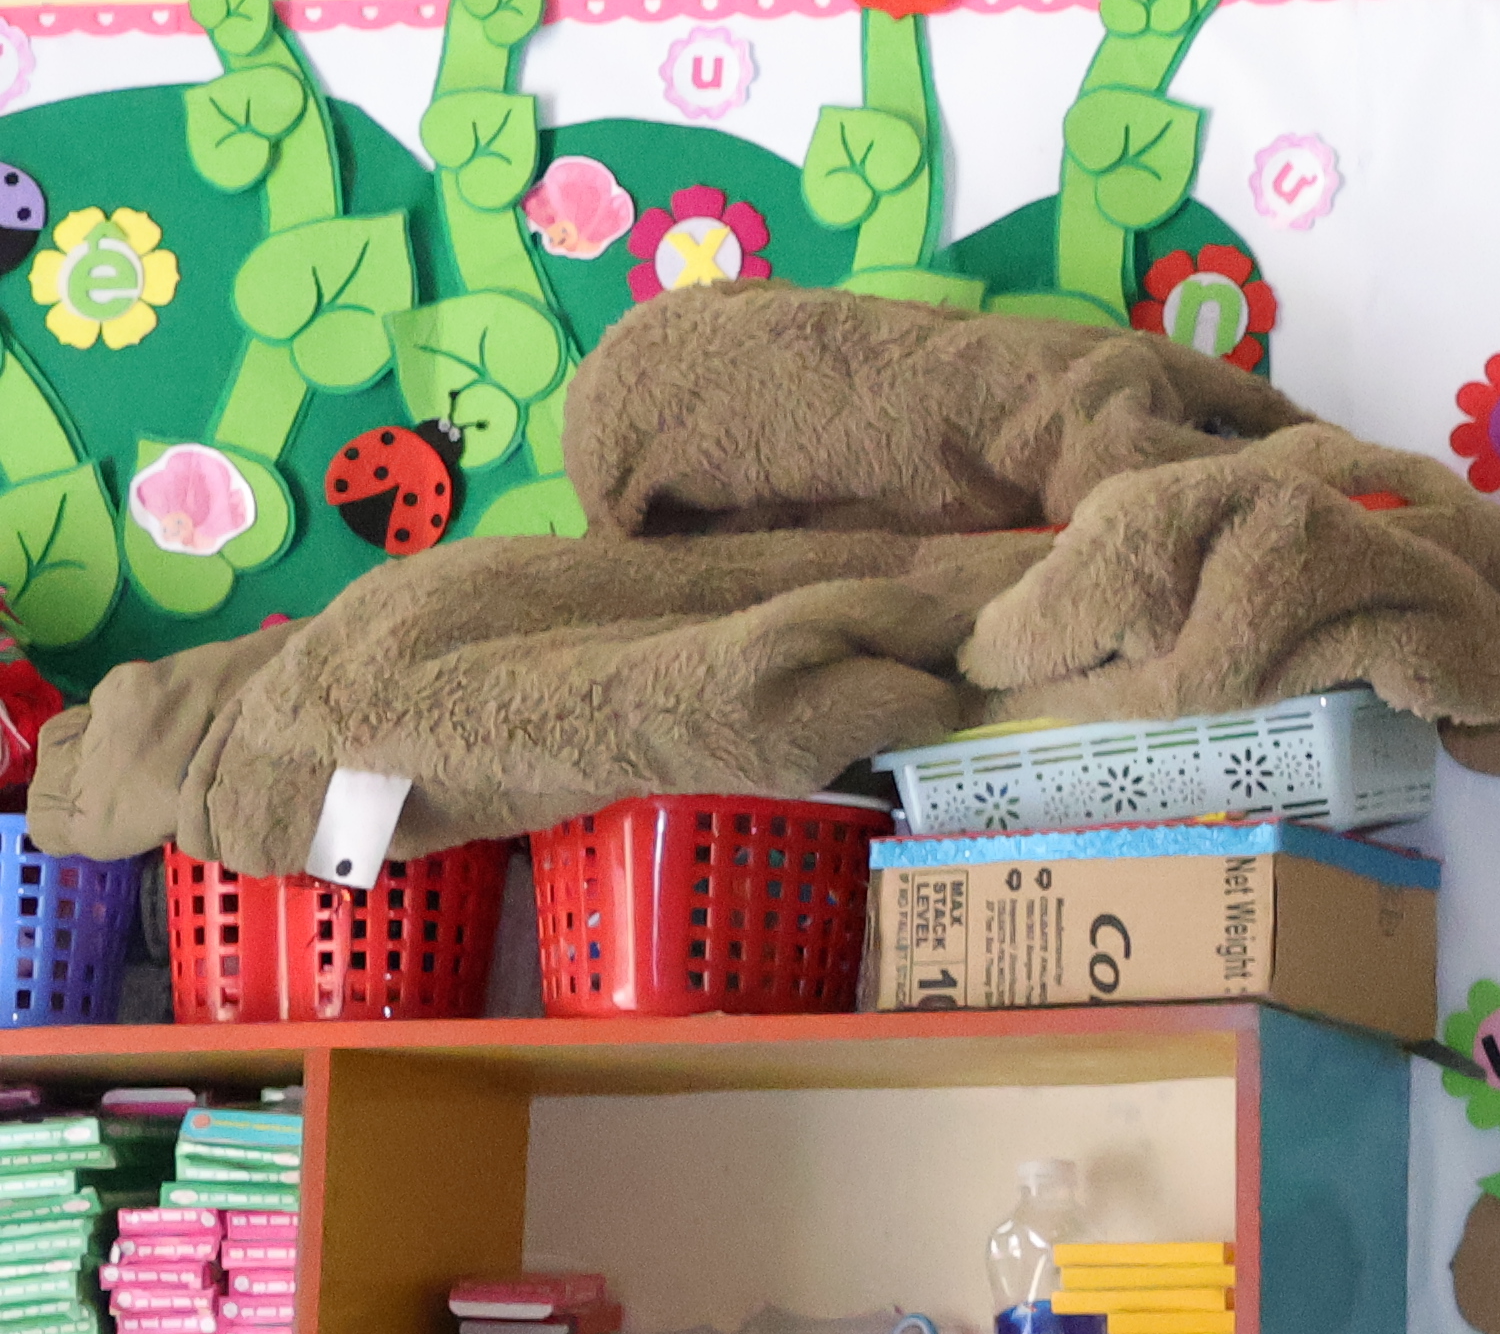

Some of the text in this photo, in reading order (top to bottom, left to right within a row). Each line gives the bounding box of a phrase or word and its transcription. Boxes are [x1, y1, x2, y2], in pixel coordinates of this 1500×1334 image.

[915, 883, 930, 948] LEVEL
[932, 882, 947, 951] STACK
[1089, 913, 1131, 1002] Co
